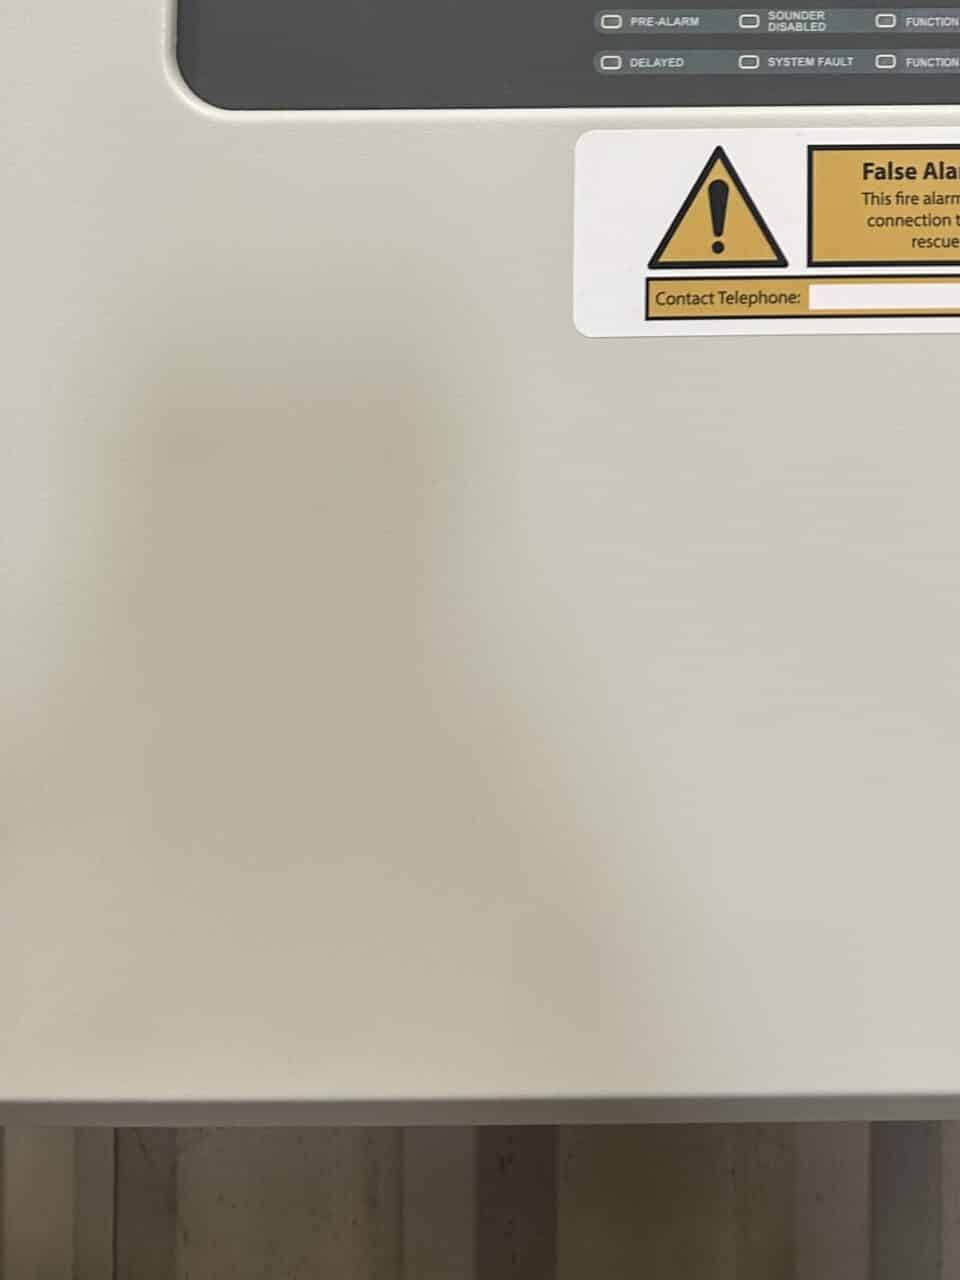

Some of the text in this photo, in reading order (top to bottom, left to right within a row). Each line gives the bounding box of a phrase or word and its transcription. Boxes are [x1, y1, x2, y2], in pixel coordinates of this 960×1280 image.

[768, 11, 825, 20] SOUNDER
[630, 17, 700, 27] PRE-ALARM
[768, 22, 826, 32] DISABLED
[905, 17, 959, 27] FUNCTION
[630, 58, 684, 68] DELAYED
[768, 57, 854, 67] SYSTEM FAULT
[905, 58, 959, 68] FUNCTION
[862, 161, 917, 180] False
[862, 191, 891, 205] This
[896, 191, 919, 205] fire
[867, 213, 951, 227] connection
[911, 237, 960, 248] rescue
[655, 290, 800, 307] Contact Telephone:
